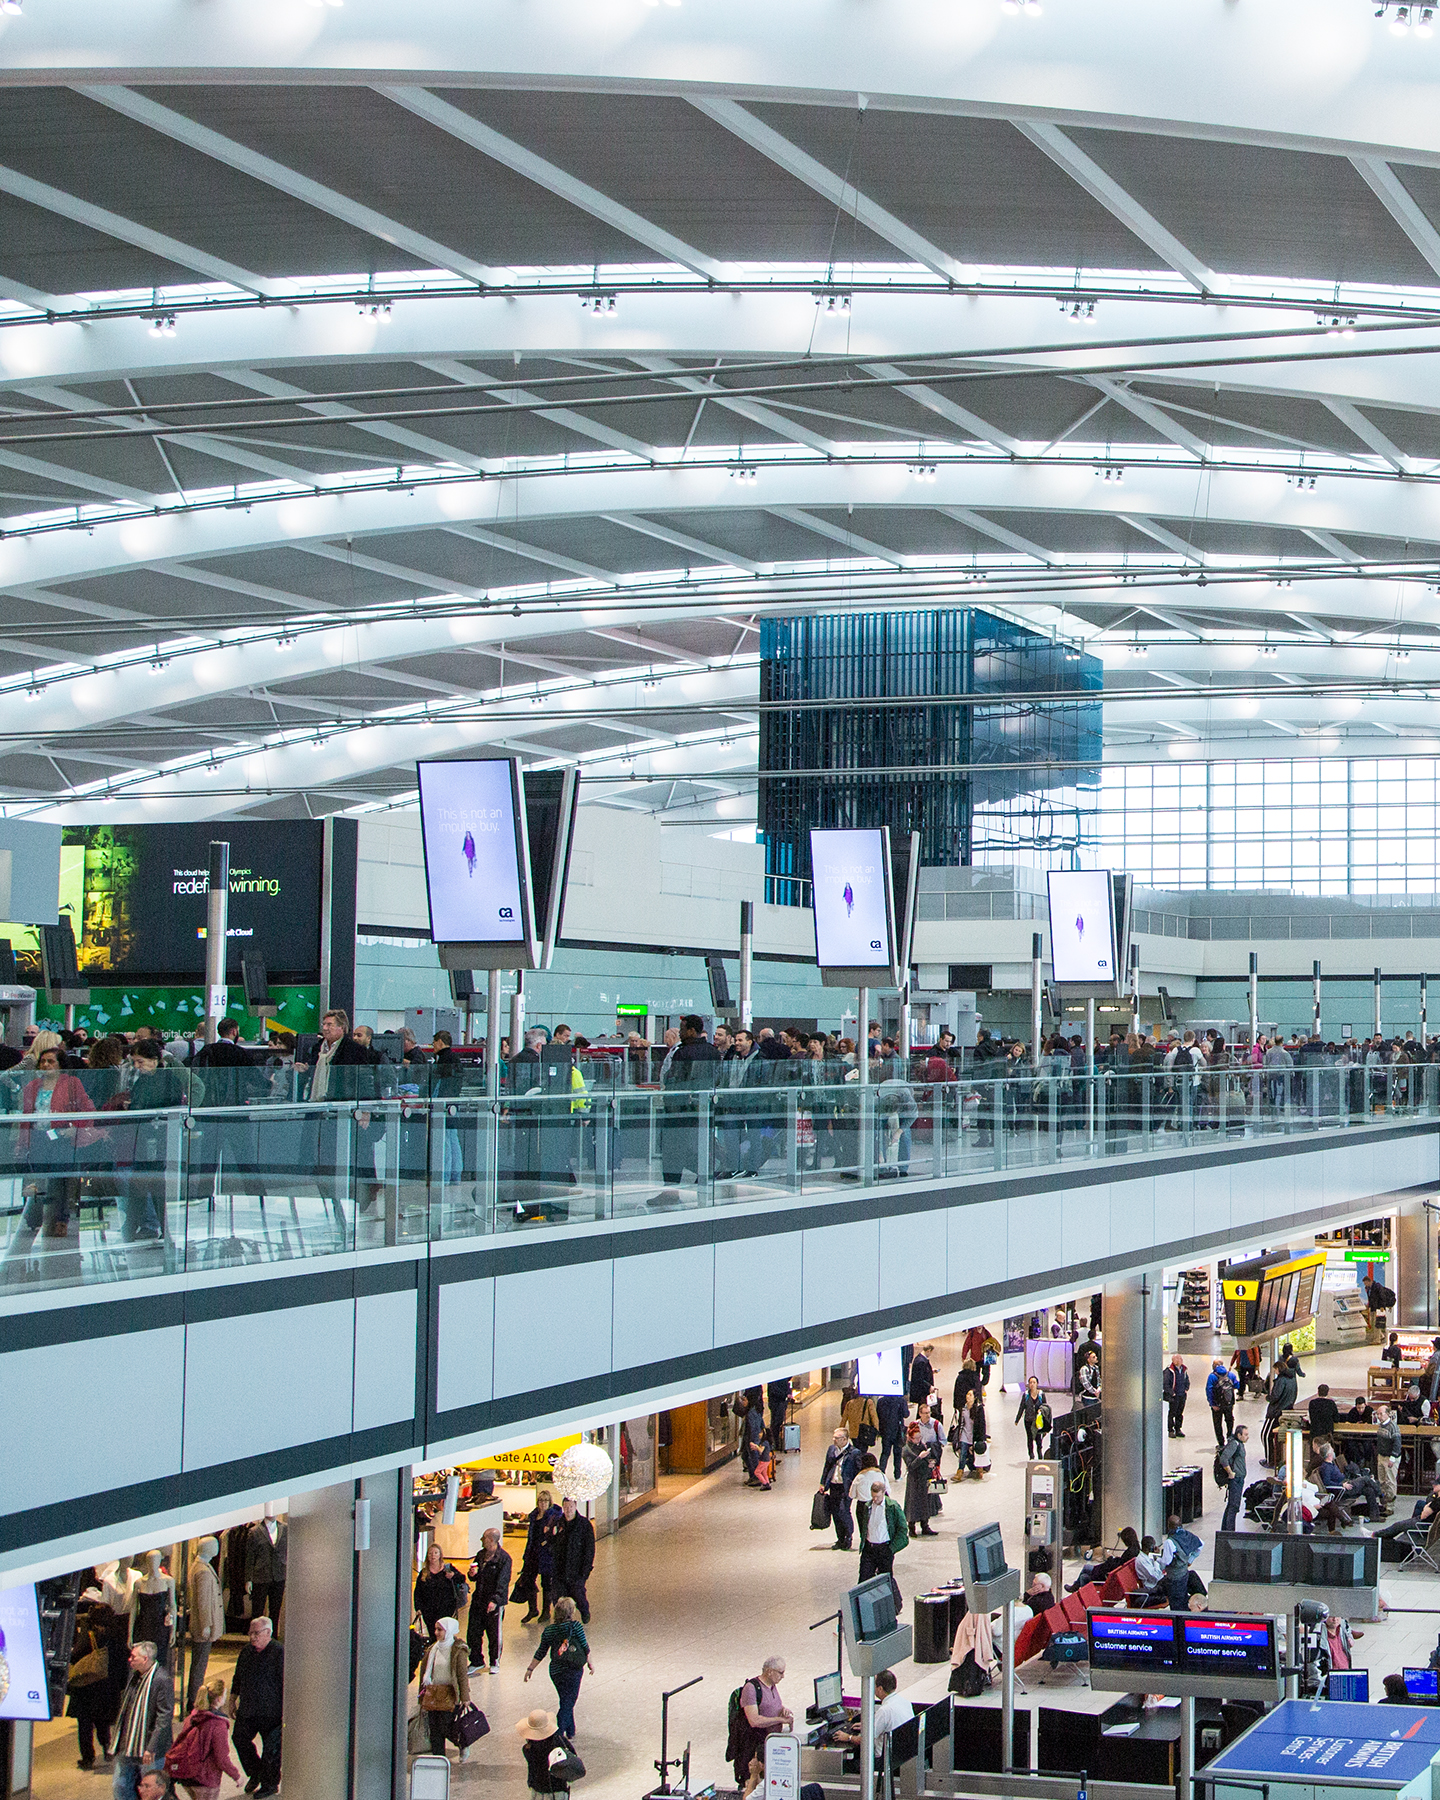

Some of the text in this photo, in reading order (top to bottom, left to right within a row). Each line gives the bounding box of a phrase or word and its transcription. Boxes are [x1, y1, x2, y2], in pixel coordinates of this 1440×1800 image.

[438, 808, 458, 819] This
[471, 808, 488, 819] not
[490, 808, 503, 818] an
[439, 820, 500, 834] impulse buy.
[229, 868, 252, 877] Olympics
[173, 876, 281, 896] redefi winning.
[235, 928, 253, 936] Cloud
[214, 994, 226, 1006] 16
[94, 1029, 108, 1039] Our
[493, 1453, 545, 1464] Gate A10
[1107, 1628, 1127, 1636] BRITISH
[1094, 1640, 1153, 1652] Customer service
[1187, 1645, 1247, 1658] Customer service
[1280, 1735, 1313, 1756] Central
[1315, 1738, 1353, 1766] Customer
[1344, 1739, 1383, 1768] AIRWAYS
[1366, 1741, 1404, 1768] BRITISH
